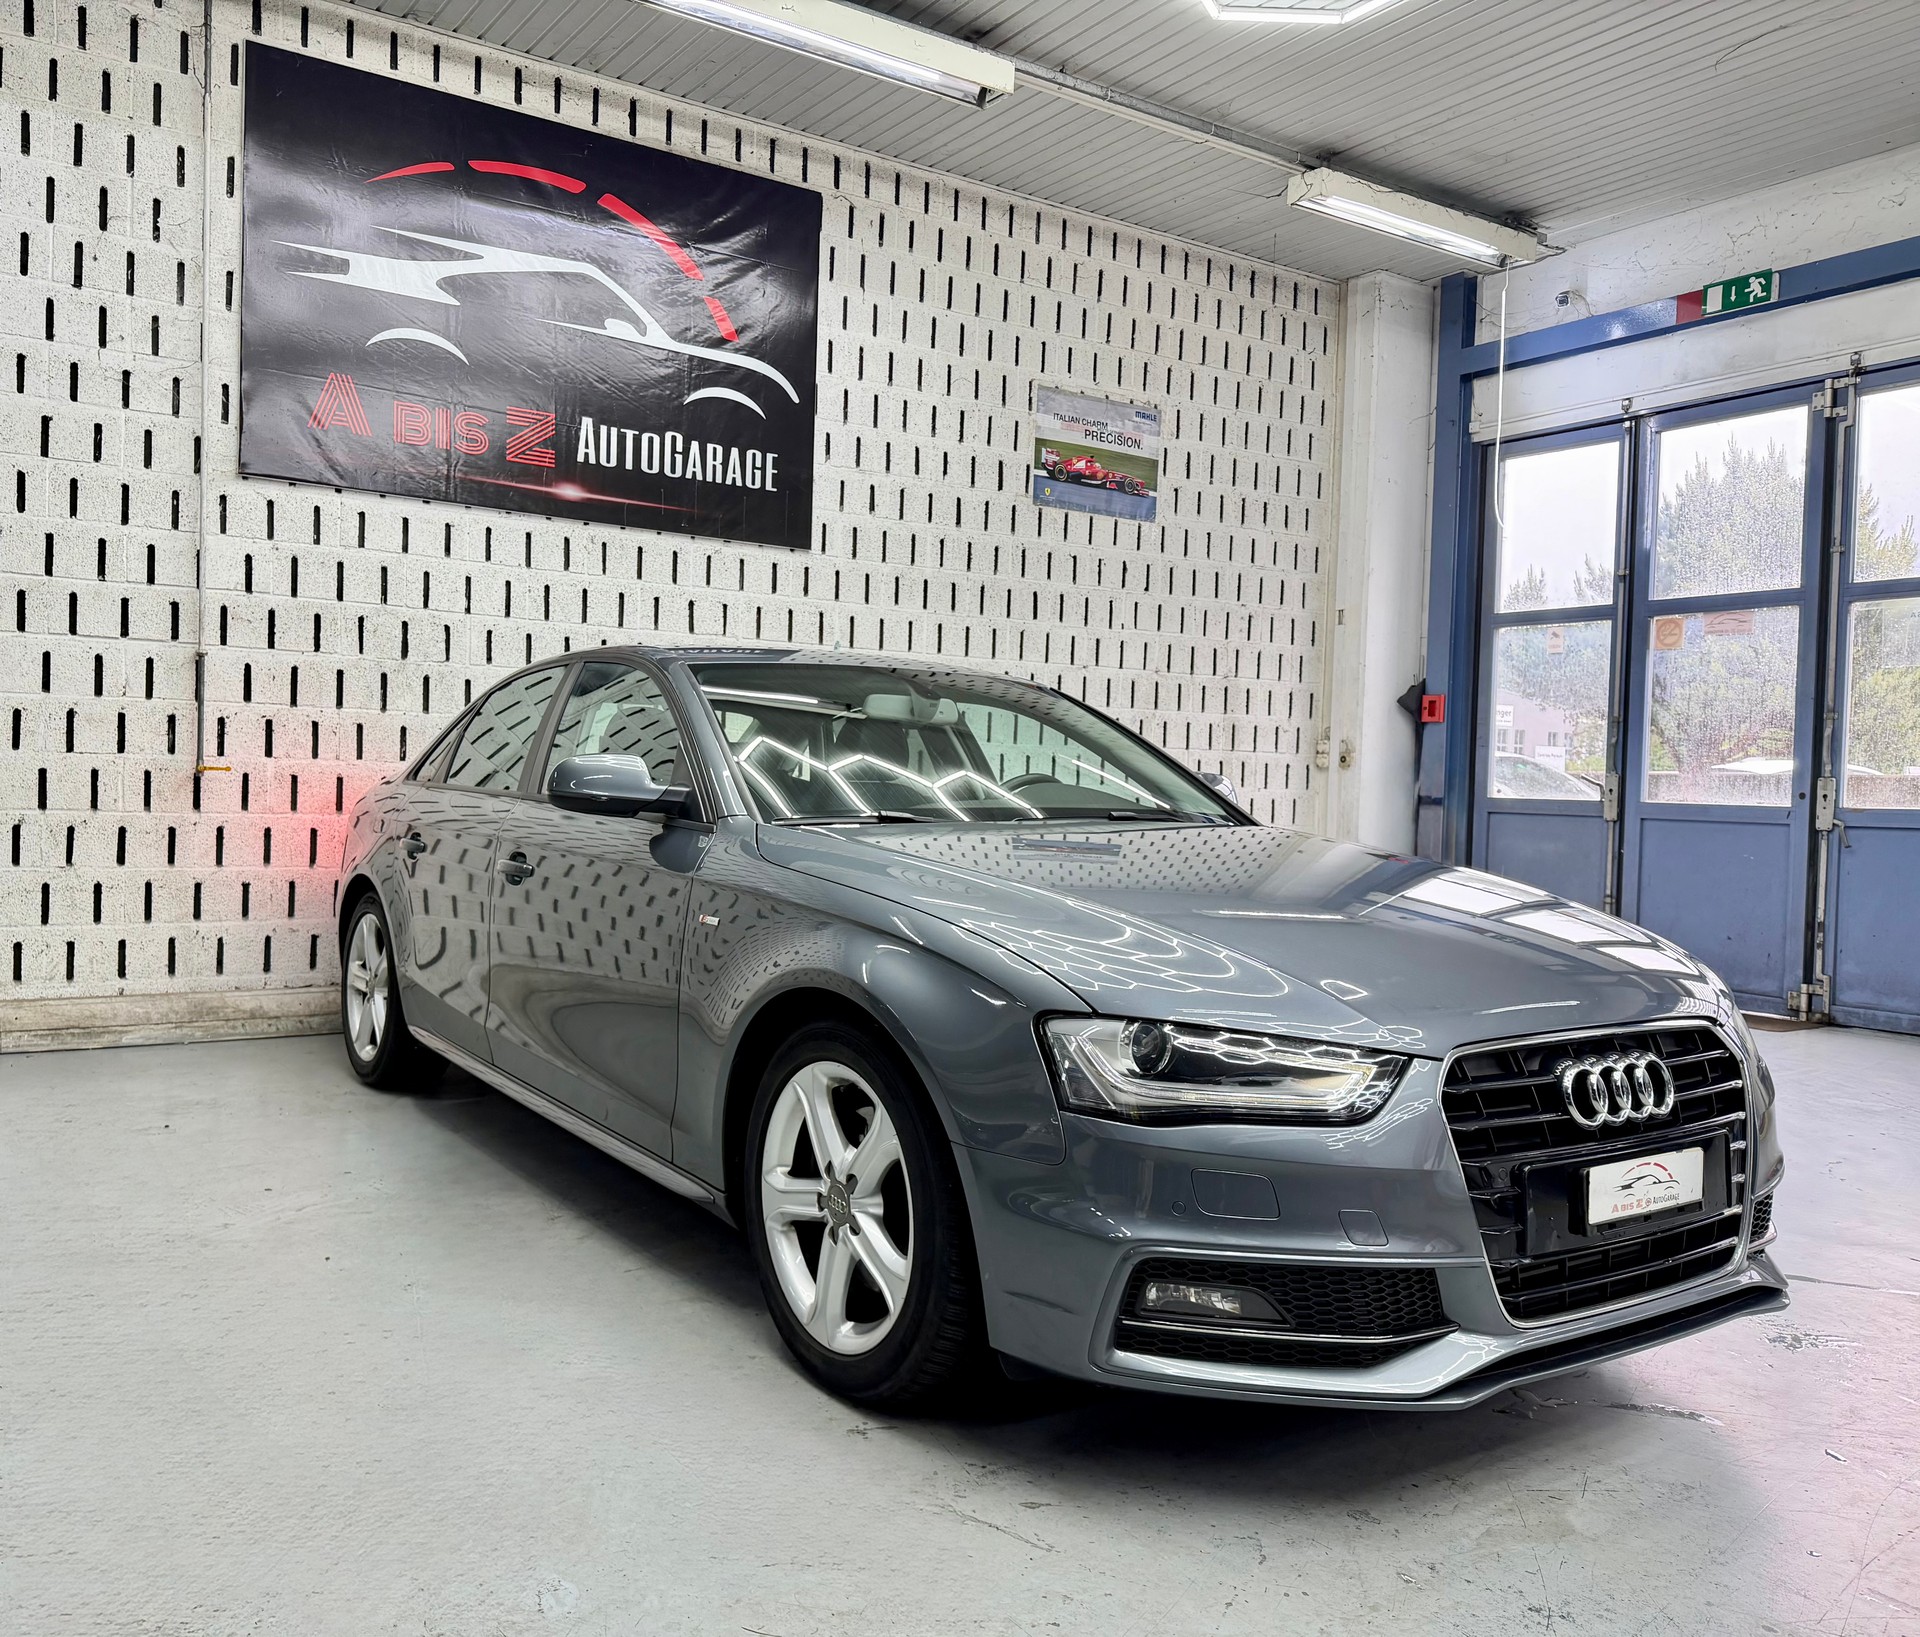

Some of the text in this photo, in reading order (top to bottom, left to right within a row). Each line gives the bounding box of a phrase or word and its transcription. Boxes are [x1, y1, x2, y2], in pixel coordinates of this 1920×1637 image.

[1053, 412, 1109, 430] ITALIAN CHARM
[1135, 411, 1158, 422] MAHLE
[307, 372, 779, 492] A BIS Z AUTOGARAGE
[1084, 429, 1144, 450] PRECISION.
[1611, 1204, 1619, 1213] A
[1621, 1203, 1634, 1211] BIS
[1636, 1198, 1644, 1208] Z
